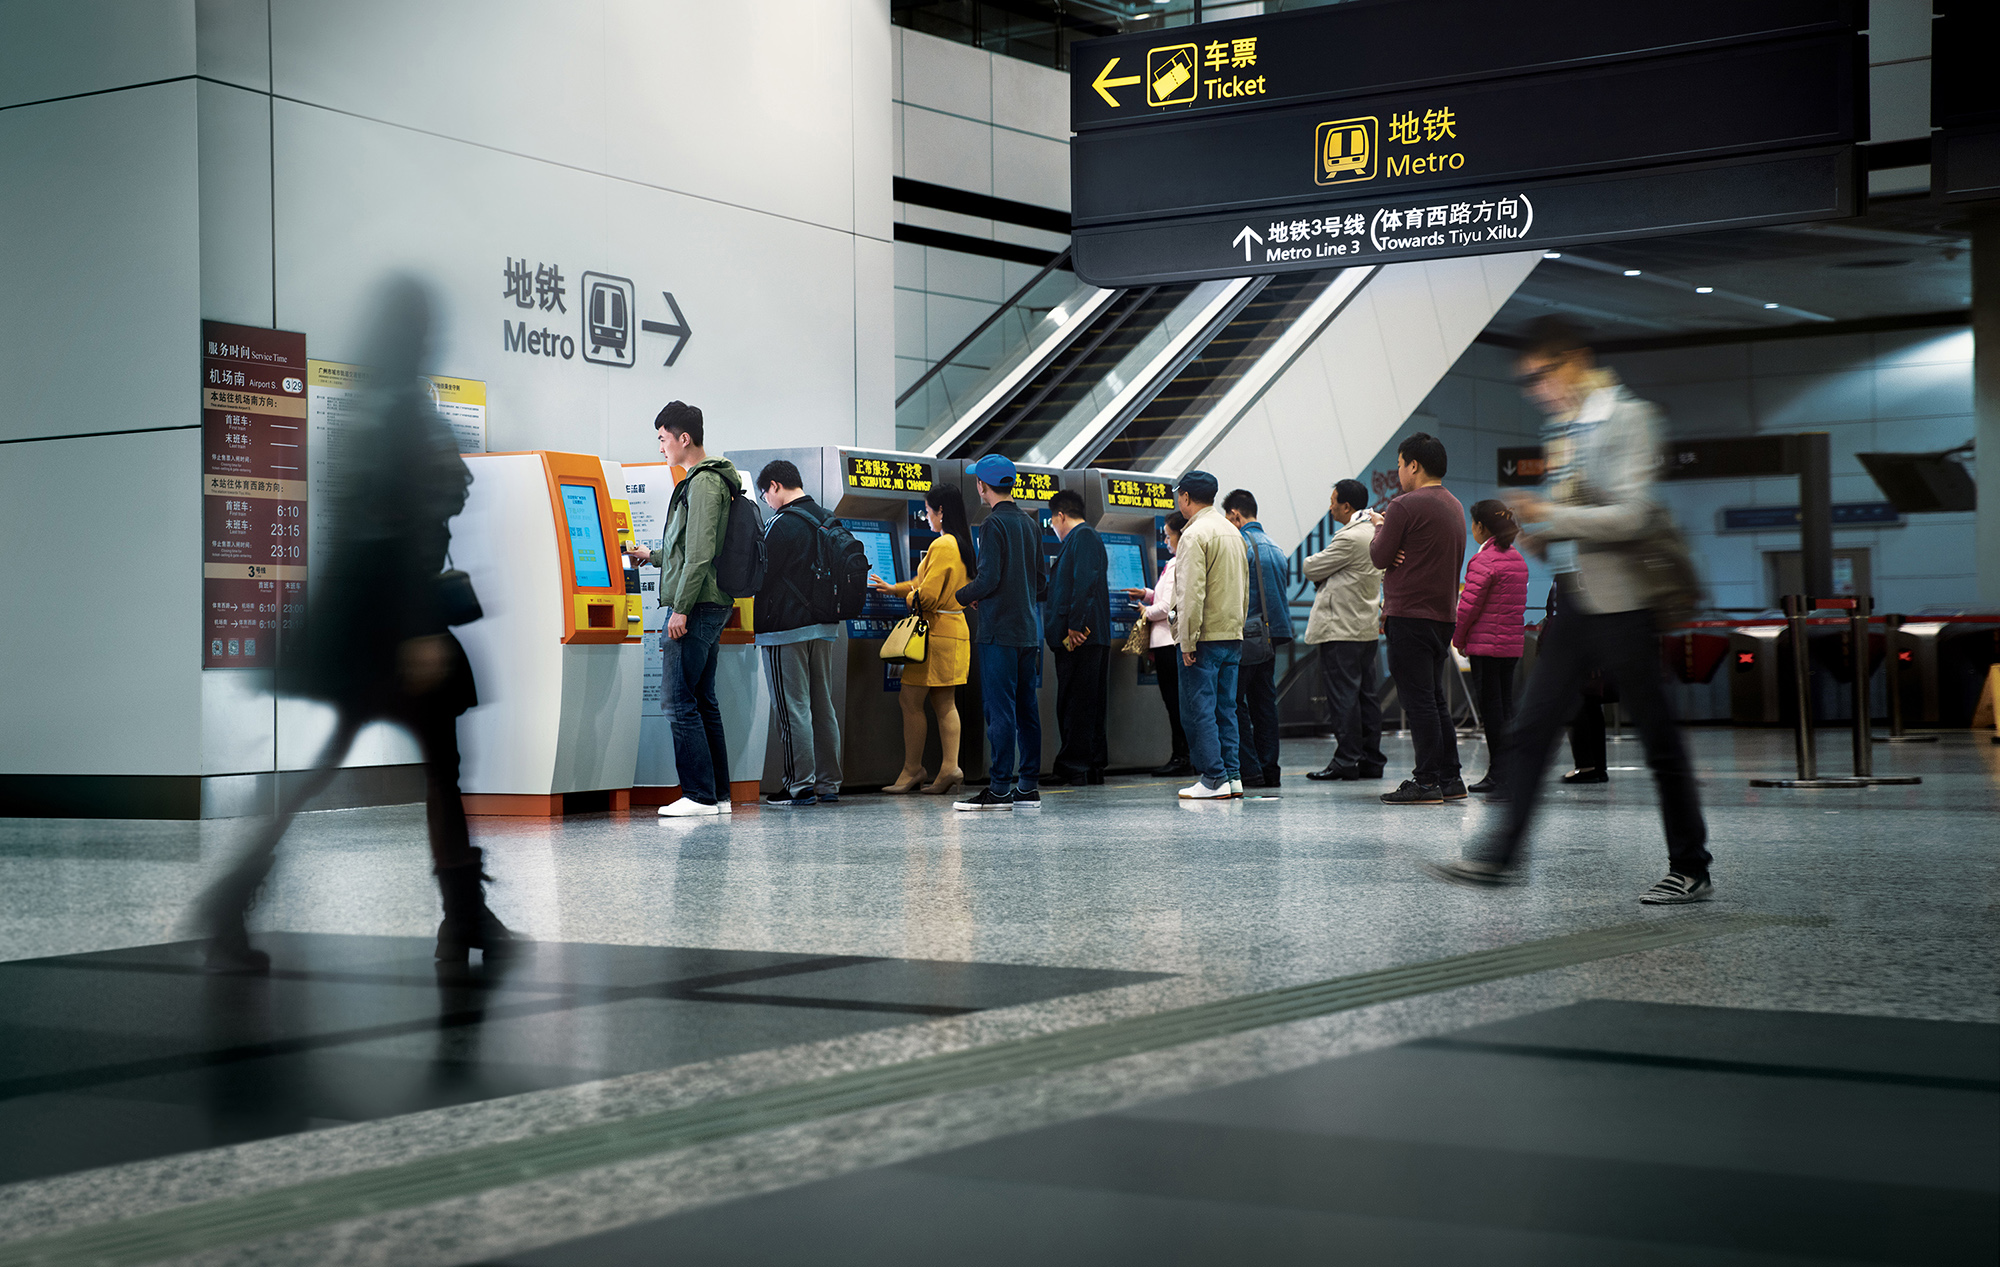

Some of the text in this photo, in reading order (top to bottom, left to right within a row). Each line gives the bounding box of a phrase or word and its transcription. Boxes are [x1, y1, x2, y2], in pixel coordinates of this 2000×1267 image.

[1204, 37, 1258, 71] 车票
[1204, 75, 1266, 99] Ticket
[1388, 107, 1457, 145] 地铁
[1386, 152, 1465, 178] Metro
[1268, 213, 1366, 244] 地铁3号线
[1266, 224, 1518, 262] Metro Line 3 Towards Tiyu Xilu
[503, 256, 567, 315] 地铁
[503, 319, 575, 360] Metro
[208, 341, 288, 363] 服务时间 Service Time
[209, 368, 245, 387] 机场南
[249, 379, 271, 389] Airport
[848, 474, 858, 486] IN
[277, 505, 299, 518] 6:10
[1107, 493, 1116, 504] IN
[1153, 497, 1175, 509] CHANGE
[270, 523, 300, 537] 23:15
[270, 544, 300, 558] 23:10
[259, 603, 276, 613] 6:10
[259, 620, 276, 629] 6:10
